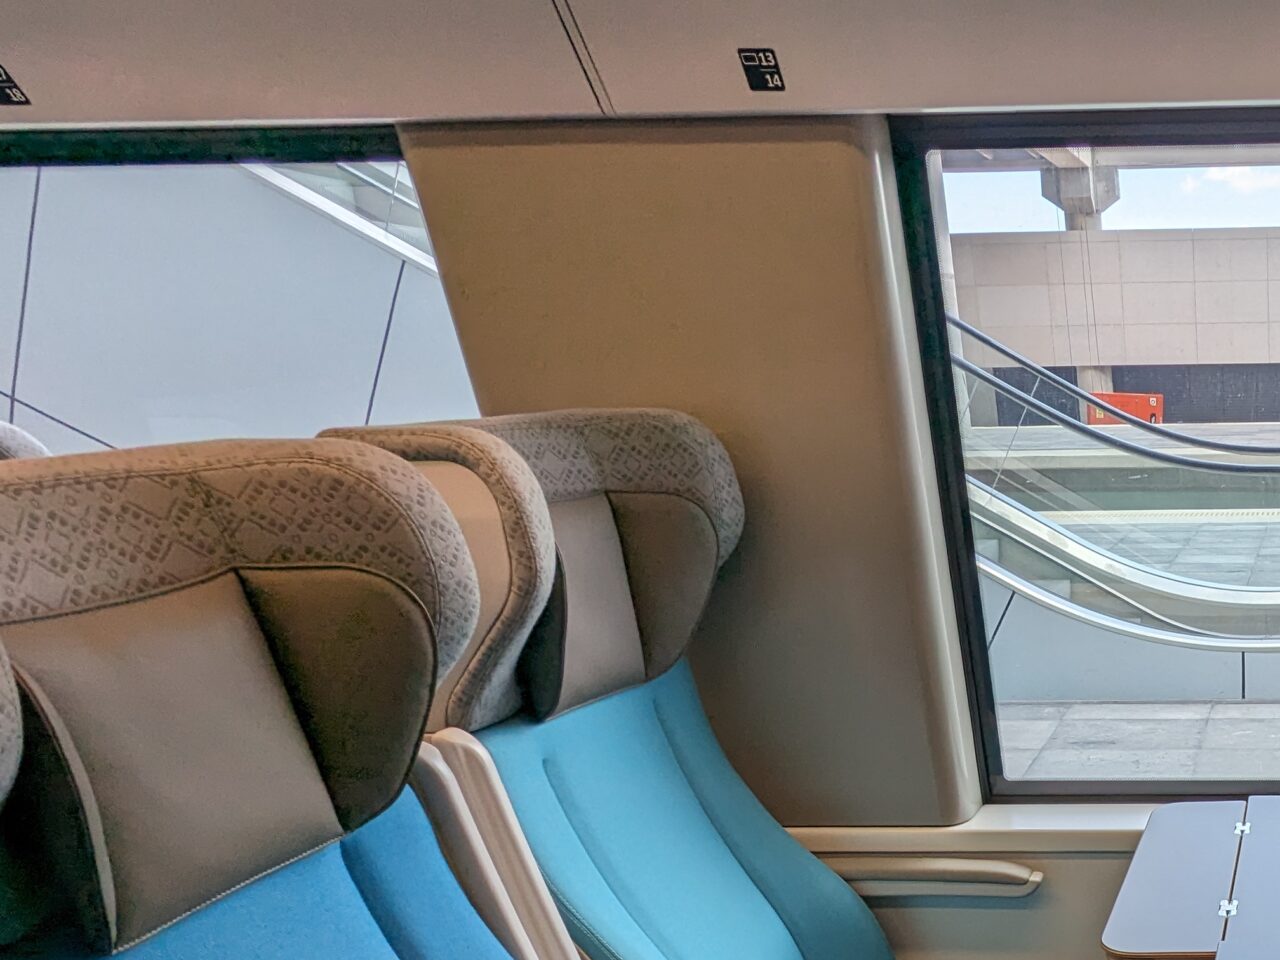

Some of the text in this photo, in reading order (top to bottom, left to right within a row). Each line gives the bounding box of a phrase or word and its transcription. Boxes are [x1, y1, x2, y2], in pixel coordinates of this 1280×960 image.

[758, 52, 775, 66] 13
[765, 74, 782, 88] 14
[5, 88, 26, 101] 18
